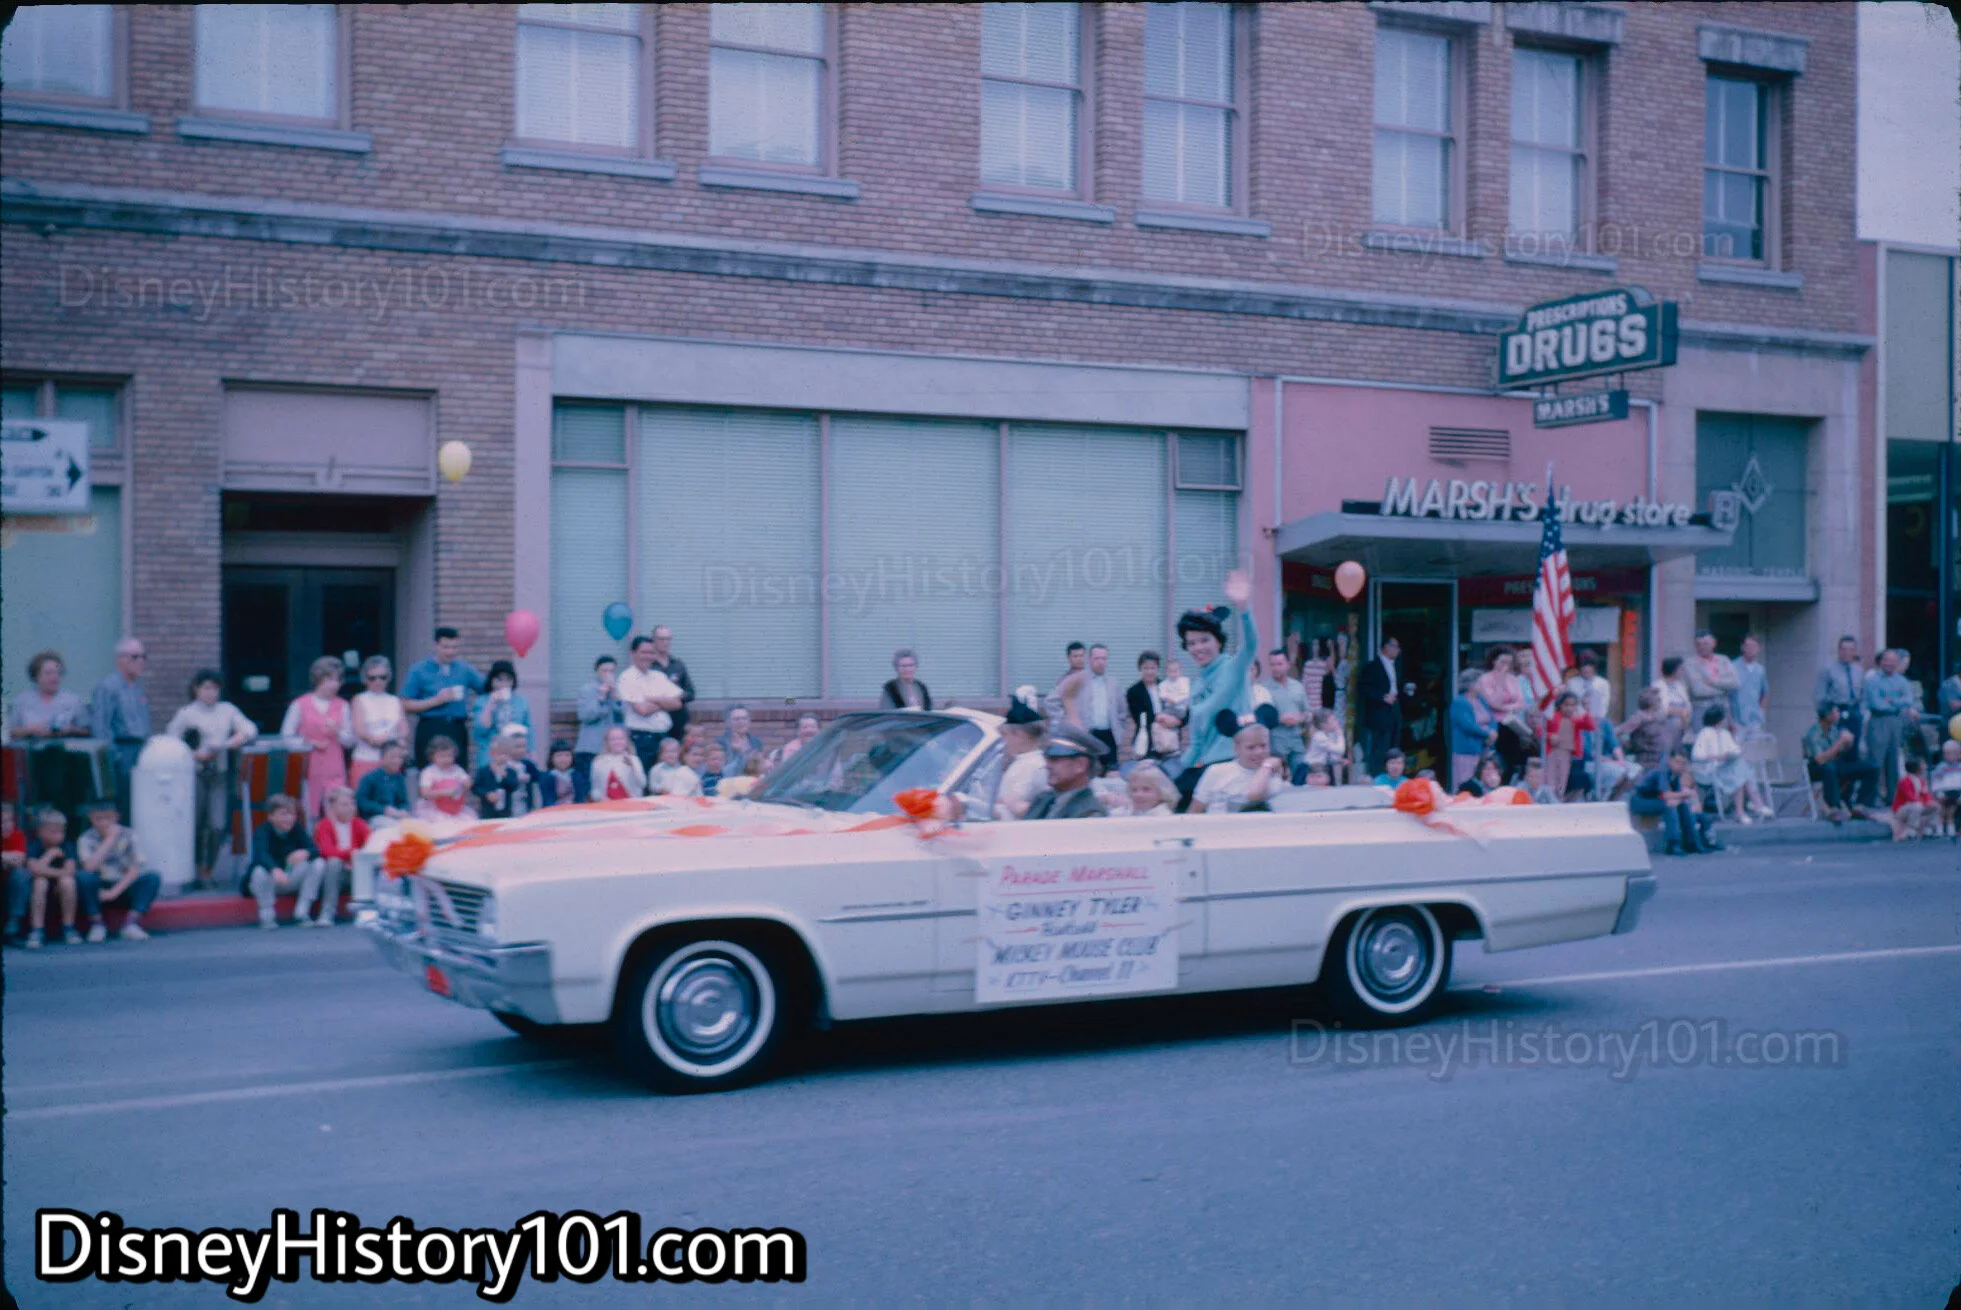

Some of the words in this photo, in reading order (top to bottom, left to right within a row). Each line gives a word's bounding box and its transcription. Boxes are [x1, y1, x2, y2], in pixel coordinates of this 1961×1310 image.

[1506, 313, 1648, 376] DRUGS
[1381, 477, 1540, 522] MARSH'S
[1556, 485, 1618, 530] drug
[1623, 496, 1692, 527] store
[1089, 896, 1142, 916] TYLER
